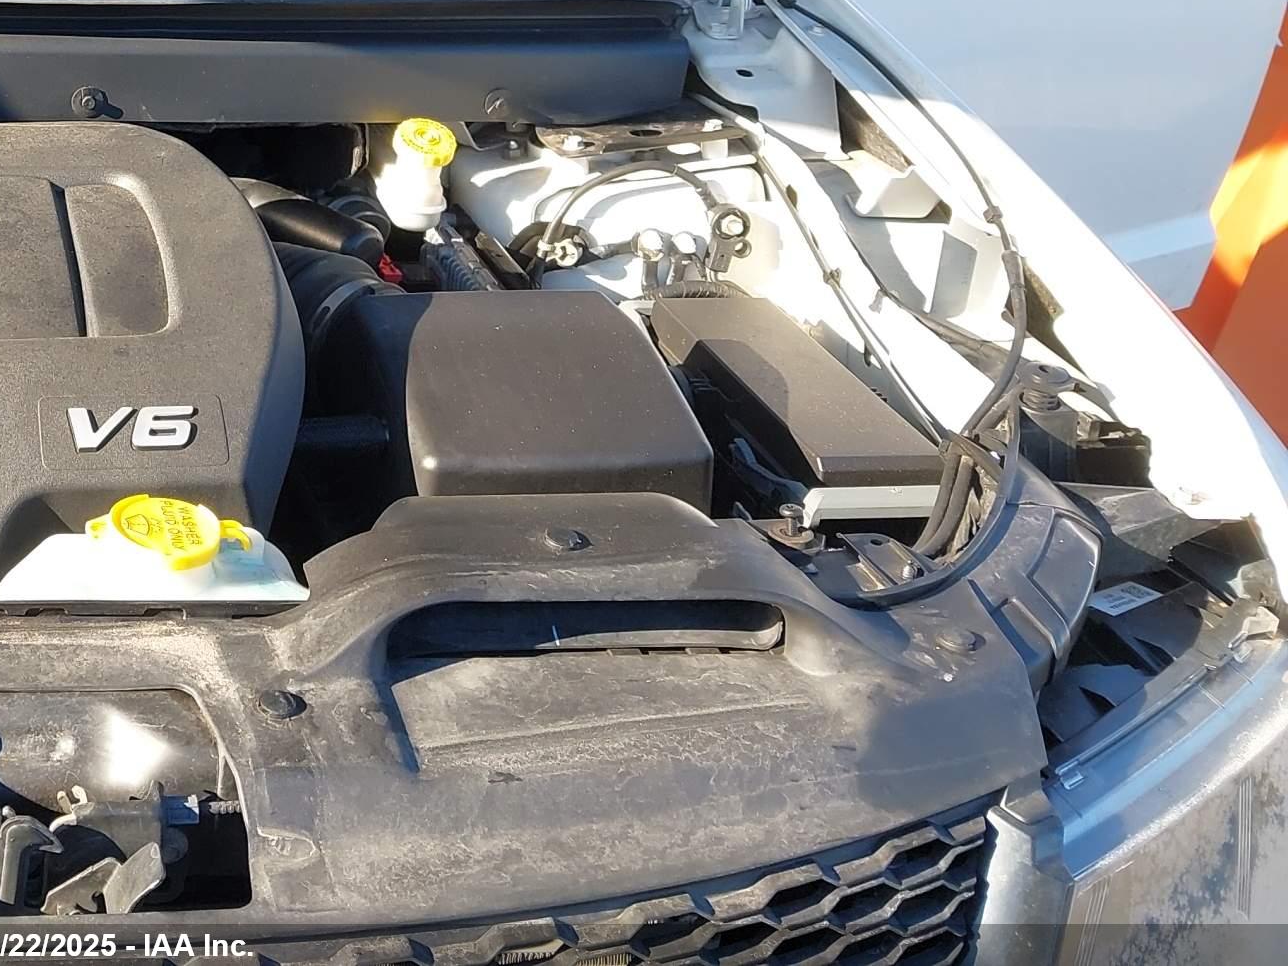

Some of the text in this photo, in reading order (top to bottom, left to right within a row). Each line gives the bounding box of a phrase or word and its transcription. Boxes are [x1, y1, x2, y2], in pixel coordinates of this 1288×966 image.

[66, 405, 199, 455] V6
[160, 500, 188, 551] FLUID ONLY
[178, 506, 203, 546] WASHER
